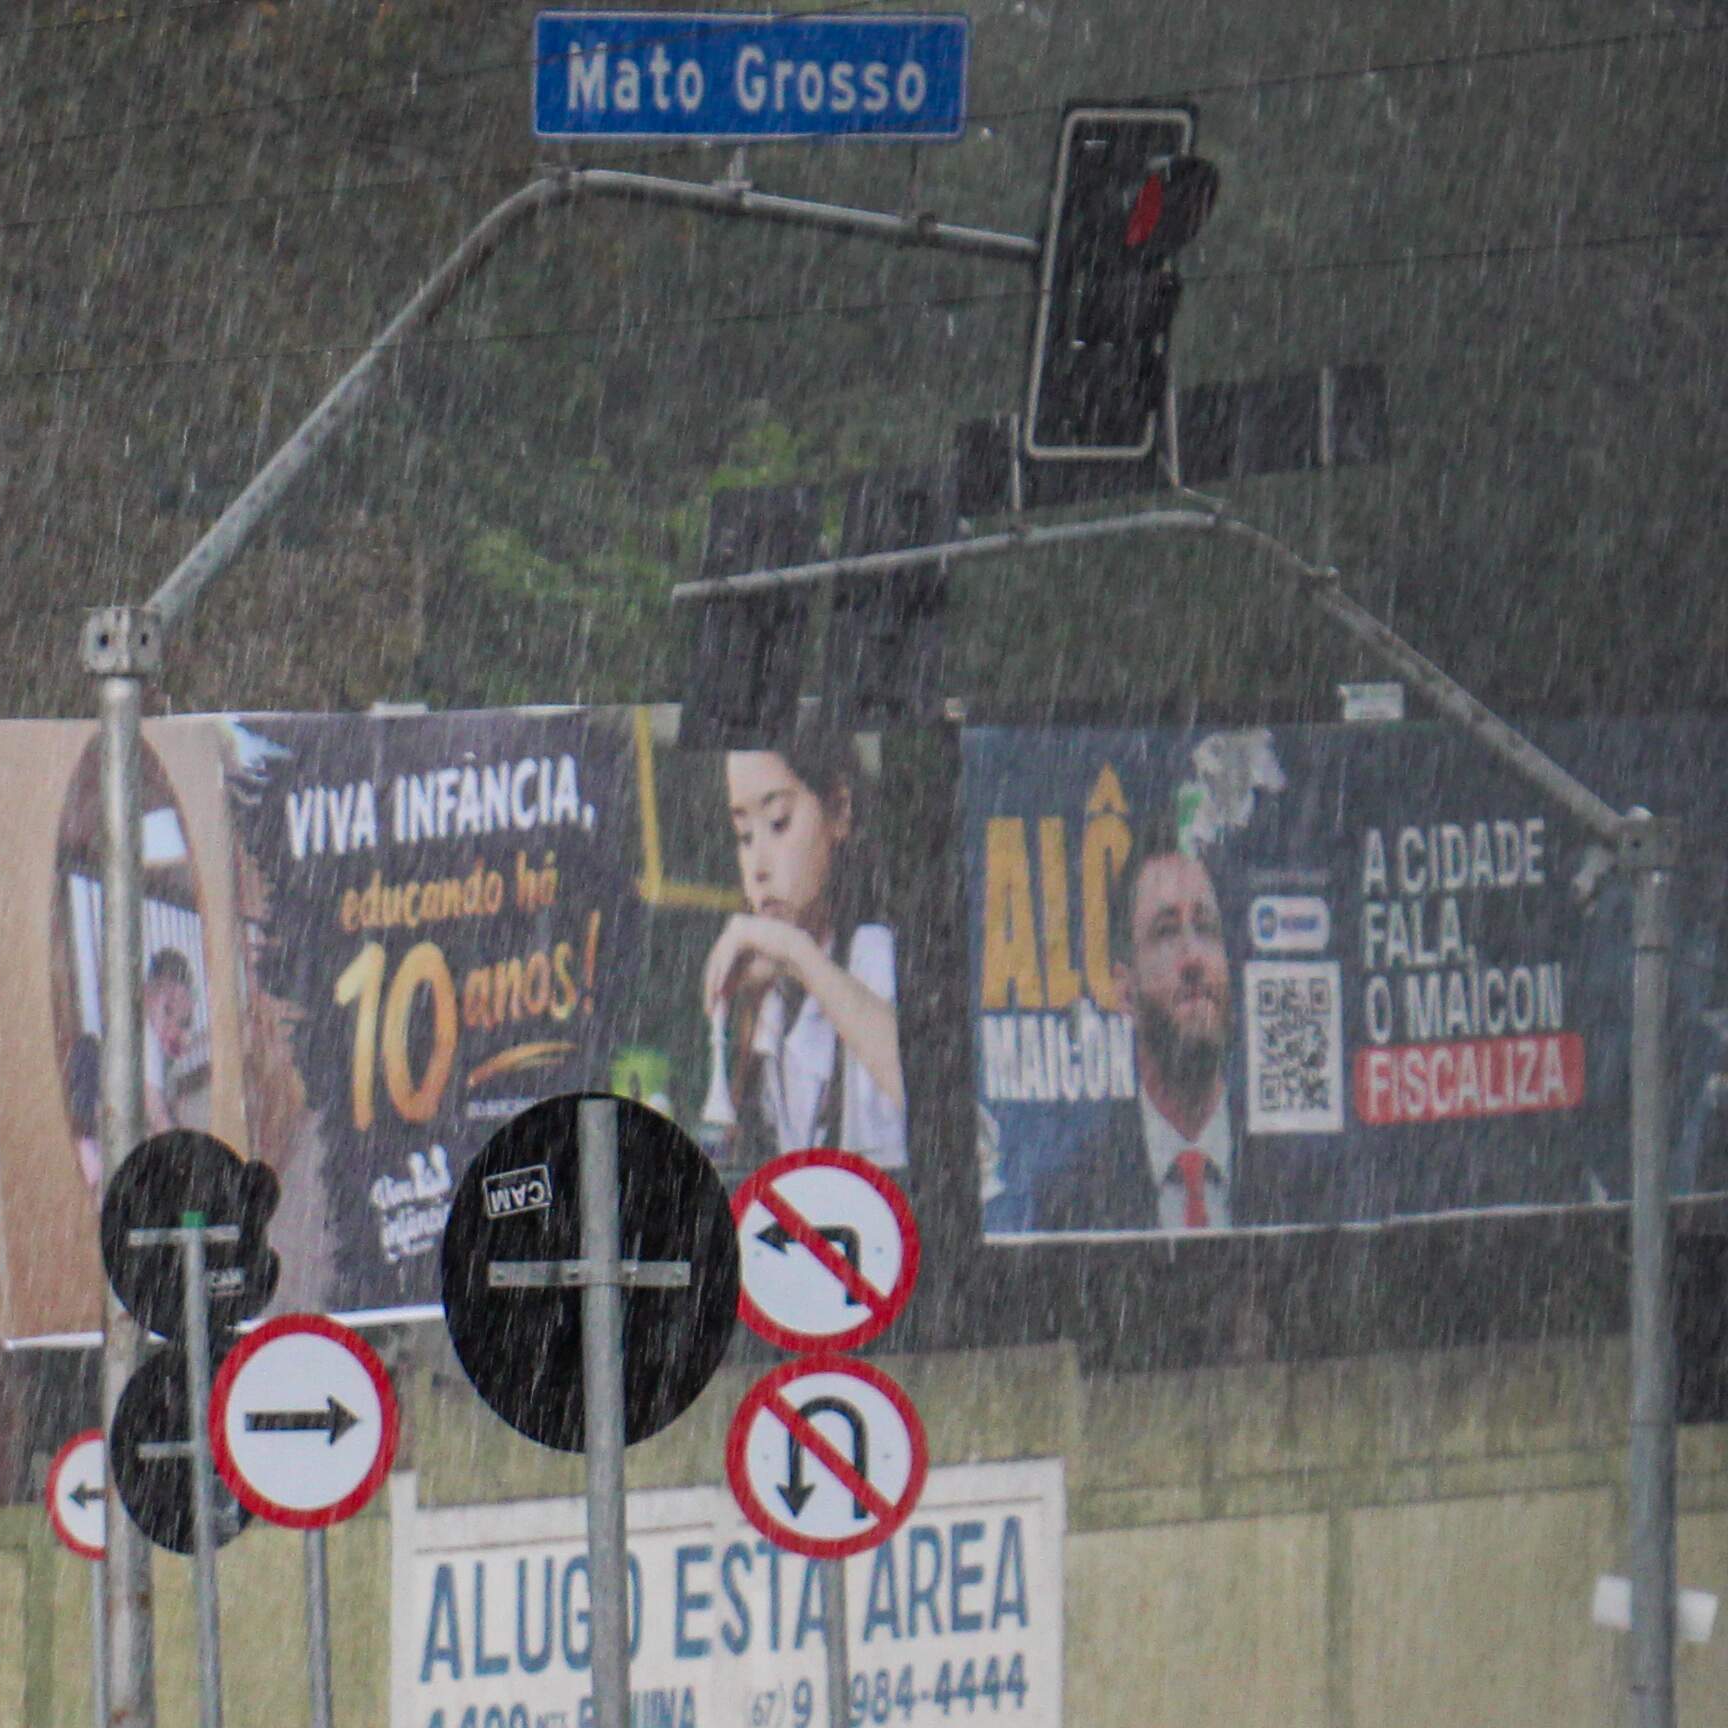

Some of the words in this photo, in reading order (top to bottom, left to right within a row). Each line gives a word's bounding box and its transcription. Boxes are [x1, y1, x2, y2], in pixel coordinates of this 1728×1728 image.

[566, 40, 705, 112] Mato
[734, 44, 928, 113] Grosso
[286, 779, 378, 860] VIVA
[1362, 827, 1388, 894] A
[1397, 816, 1545, 894] CIDADE
[340, 856, 505, 935] educando
[1363, 896, 1480, 972] FALA,
[334, 940, 459, 1132] 10
[462, 908, 601, 1034] anos!
[1365, 975, 1393, 1044] O
[1404, 961, 1563, 1040] MAICON
[980, 1010, 1137, 1102] MAICON
[1366, 1037, 1568, 1119] FISCALIZA
[490, 1180, 545, 1213] CAM
[673, 1541, 829, 1658] ESTA
[862, 1514, 1030, 1643] AREA
